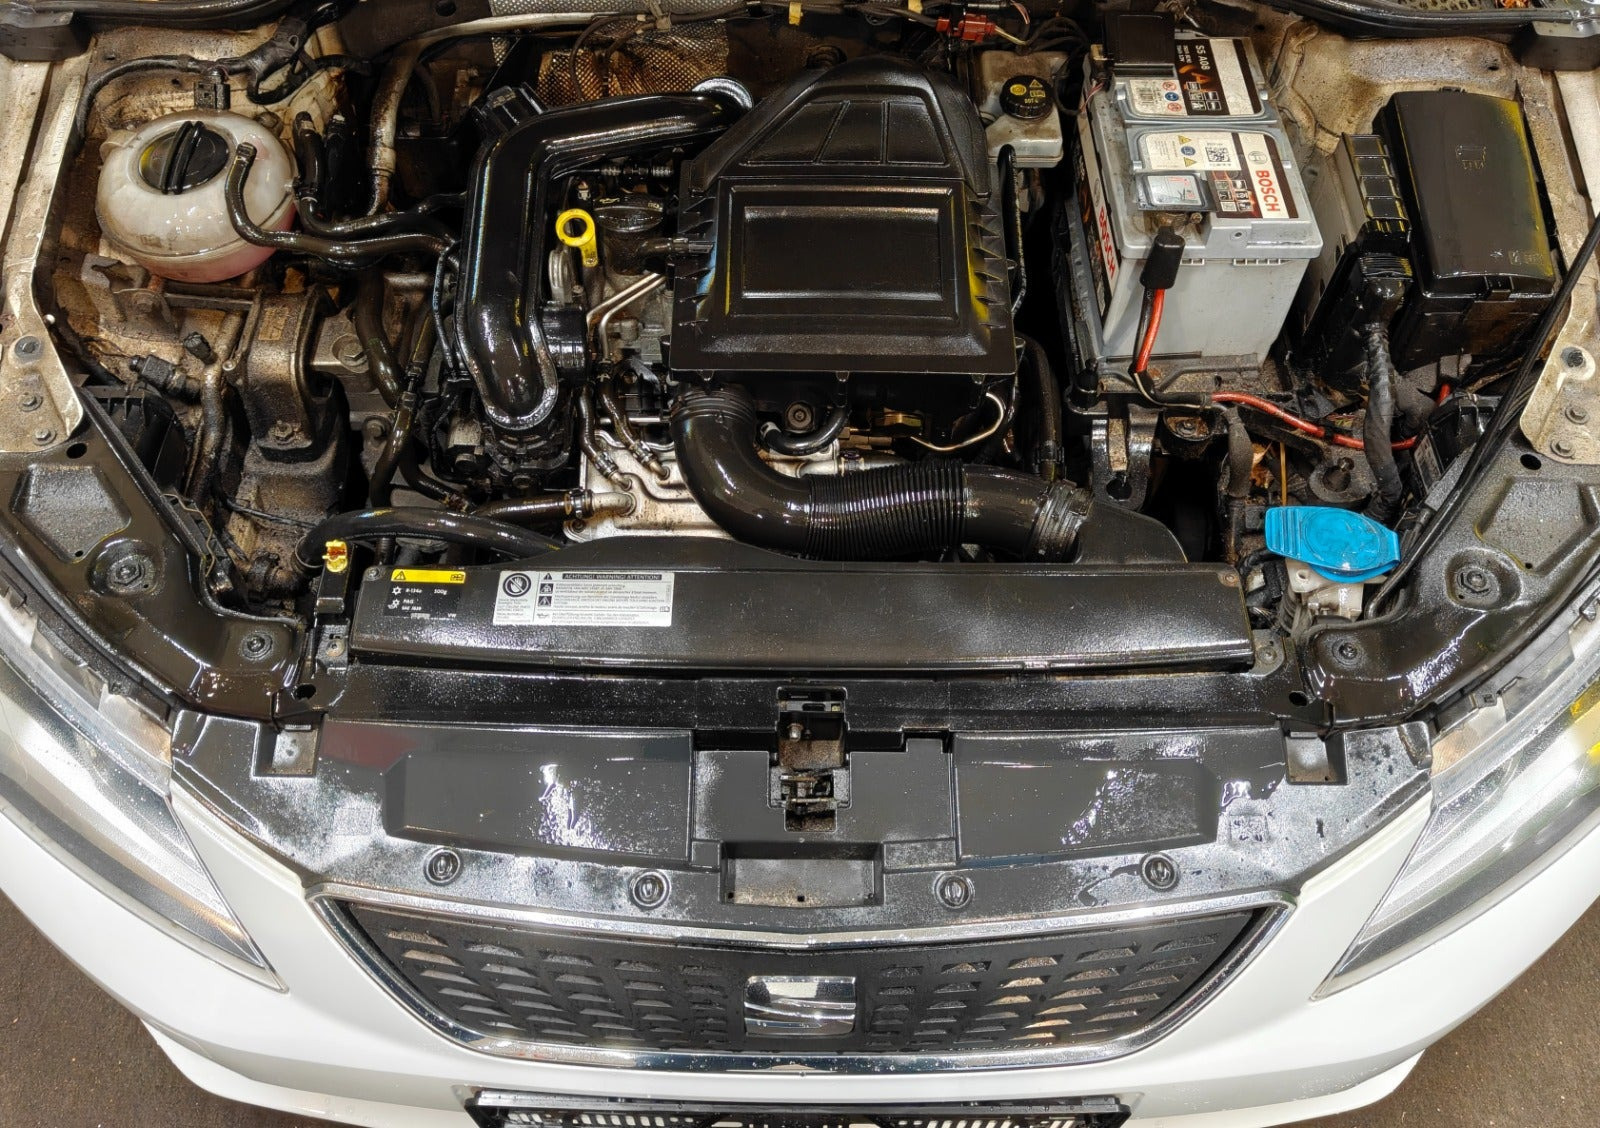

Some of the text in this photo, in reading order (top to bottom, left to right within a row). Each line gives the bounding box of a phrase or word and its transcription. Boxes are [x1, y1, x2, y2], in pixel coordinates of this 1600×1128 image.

[1198, 55, 1211, 71] A08
[1255, 169, 1281, 213] BOSCH
[1098, 205, 1116, 281] BOSCH
[564, 573, 595, 581] ACHTUNG!
